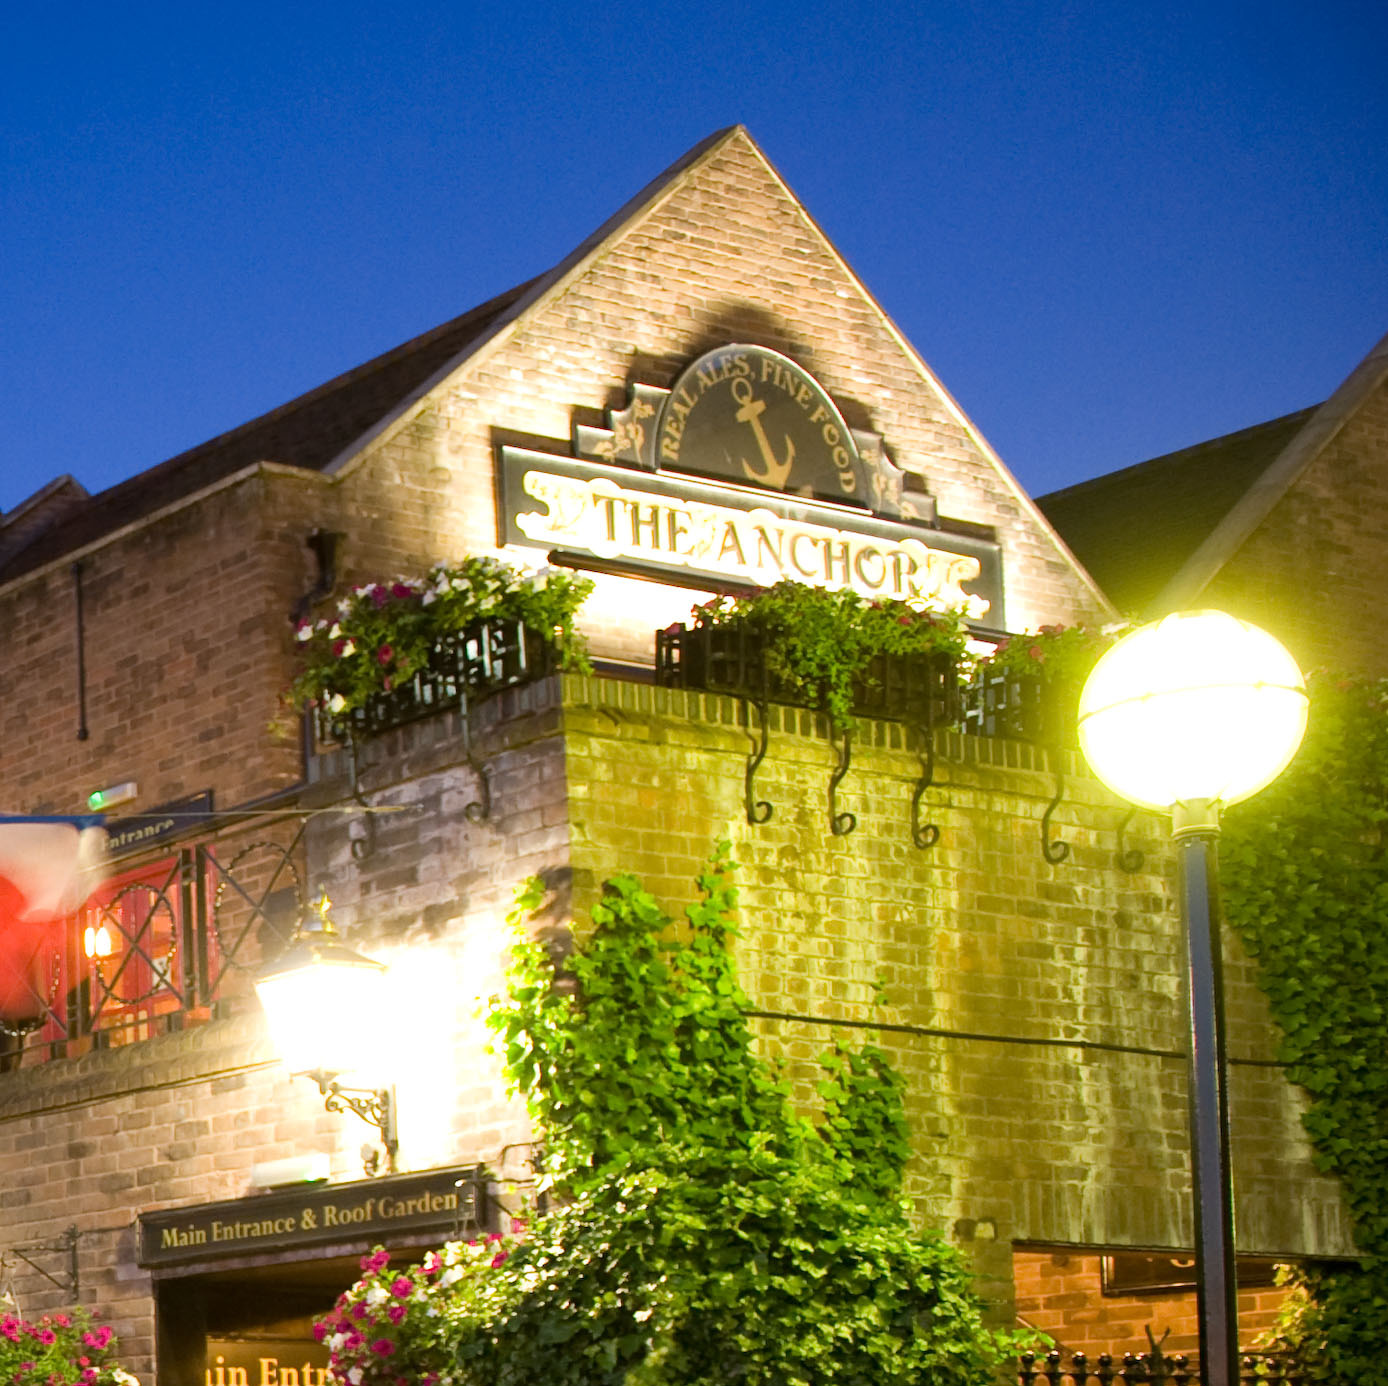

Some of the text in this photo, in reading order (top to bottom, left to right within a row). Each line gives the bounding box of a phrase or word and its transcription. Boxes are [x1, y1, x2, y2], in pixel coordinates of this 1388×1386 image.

[661, 387, 699, 461] REAL
[761, 358, 814, 409] FINE
[810, 407, 856, 493] FOOD
[593, 493, 918, 594] THE ANCHOR
[161, 1191, 458, 1248] Main Entrance & Roof Garden
